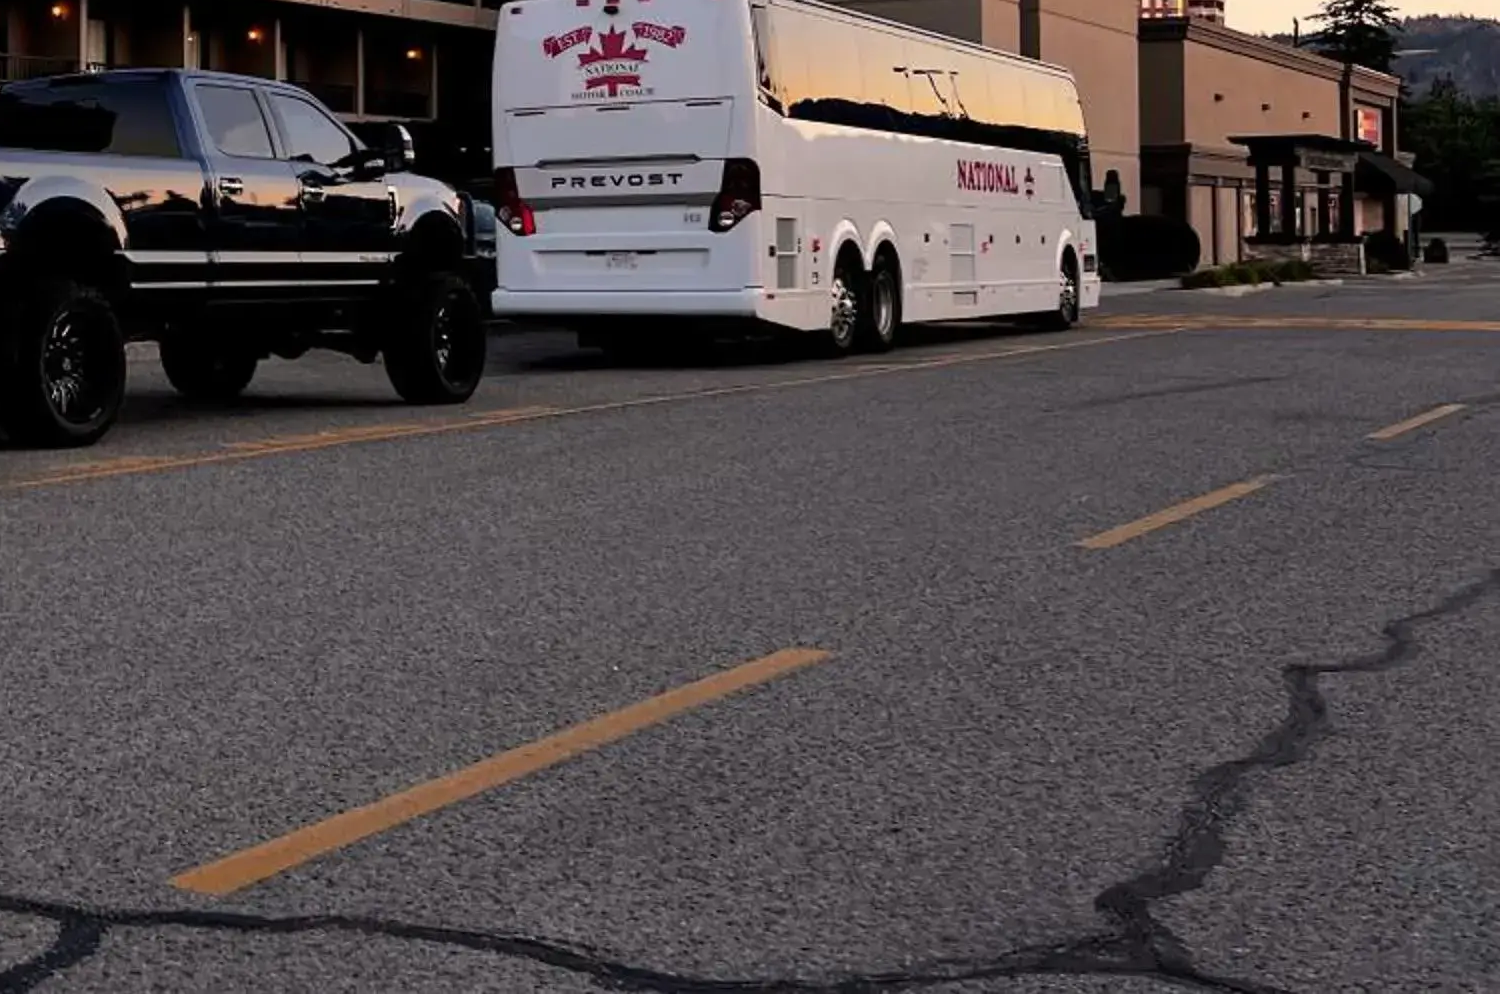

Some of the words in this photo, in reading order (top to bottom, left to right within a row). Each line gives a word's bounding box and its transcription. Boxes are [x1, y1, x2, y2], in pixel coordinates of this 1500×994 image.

[585, 62, 640, 75] NATIONAL
[551, 173, 683, 189] PREVOST
[957, 159, 1019, 194] NATIONAL
